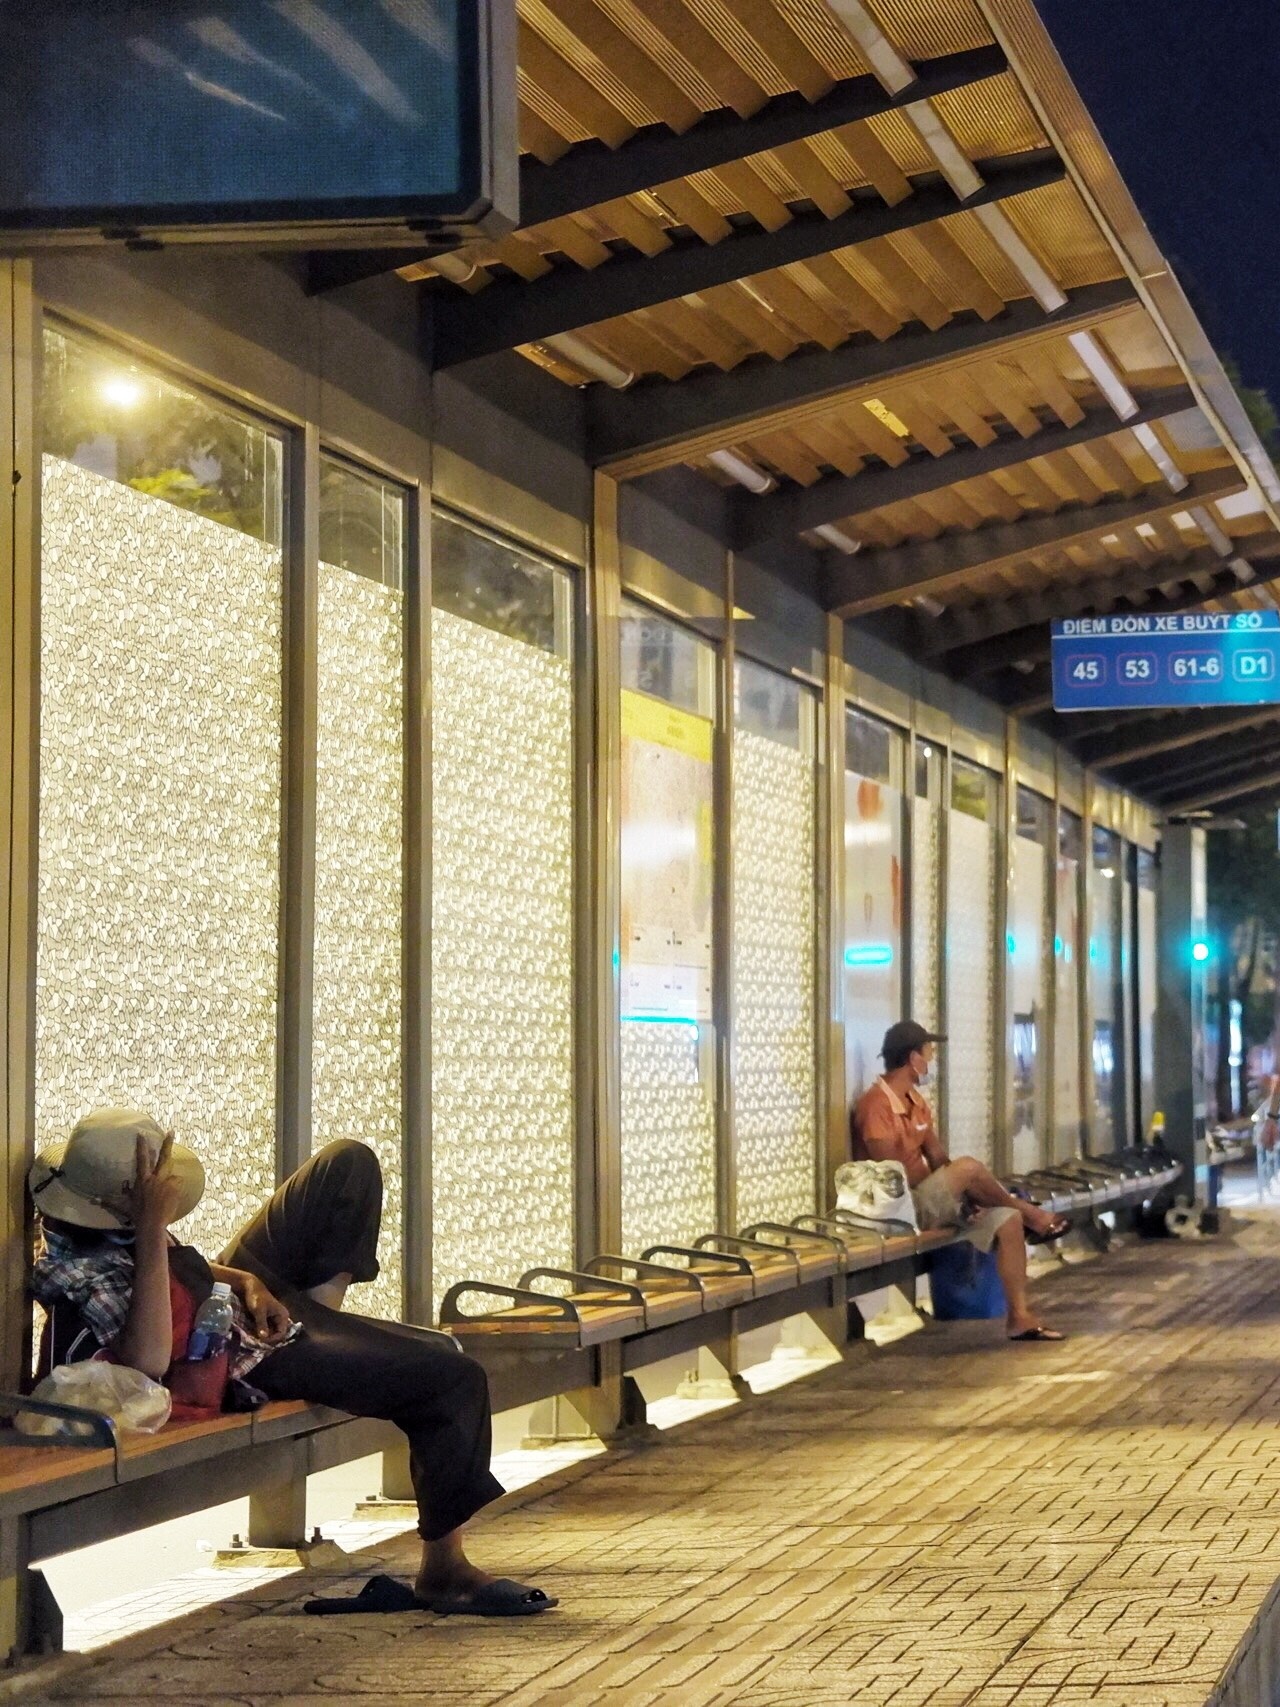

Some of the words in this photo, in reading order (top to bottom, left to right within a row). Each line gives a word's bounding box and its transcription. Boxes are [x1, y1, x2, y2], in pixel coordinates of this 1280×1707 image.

[1155, 615, 1178, 631] XE
[1073, 661, 1098, 680] 45
[1124, 659, 1150, 679] 53
[1173, 658, 1220, 677] 61-6
[1240, 656, 1268, 676] D1
